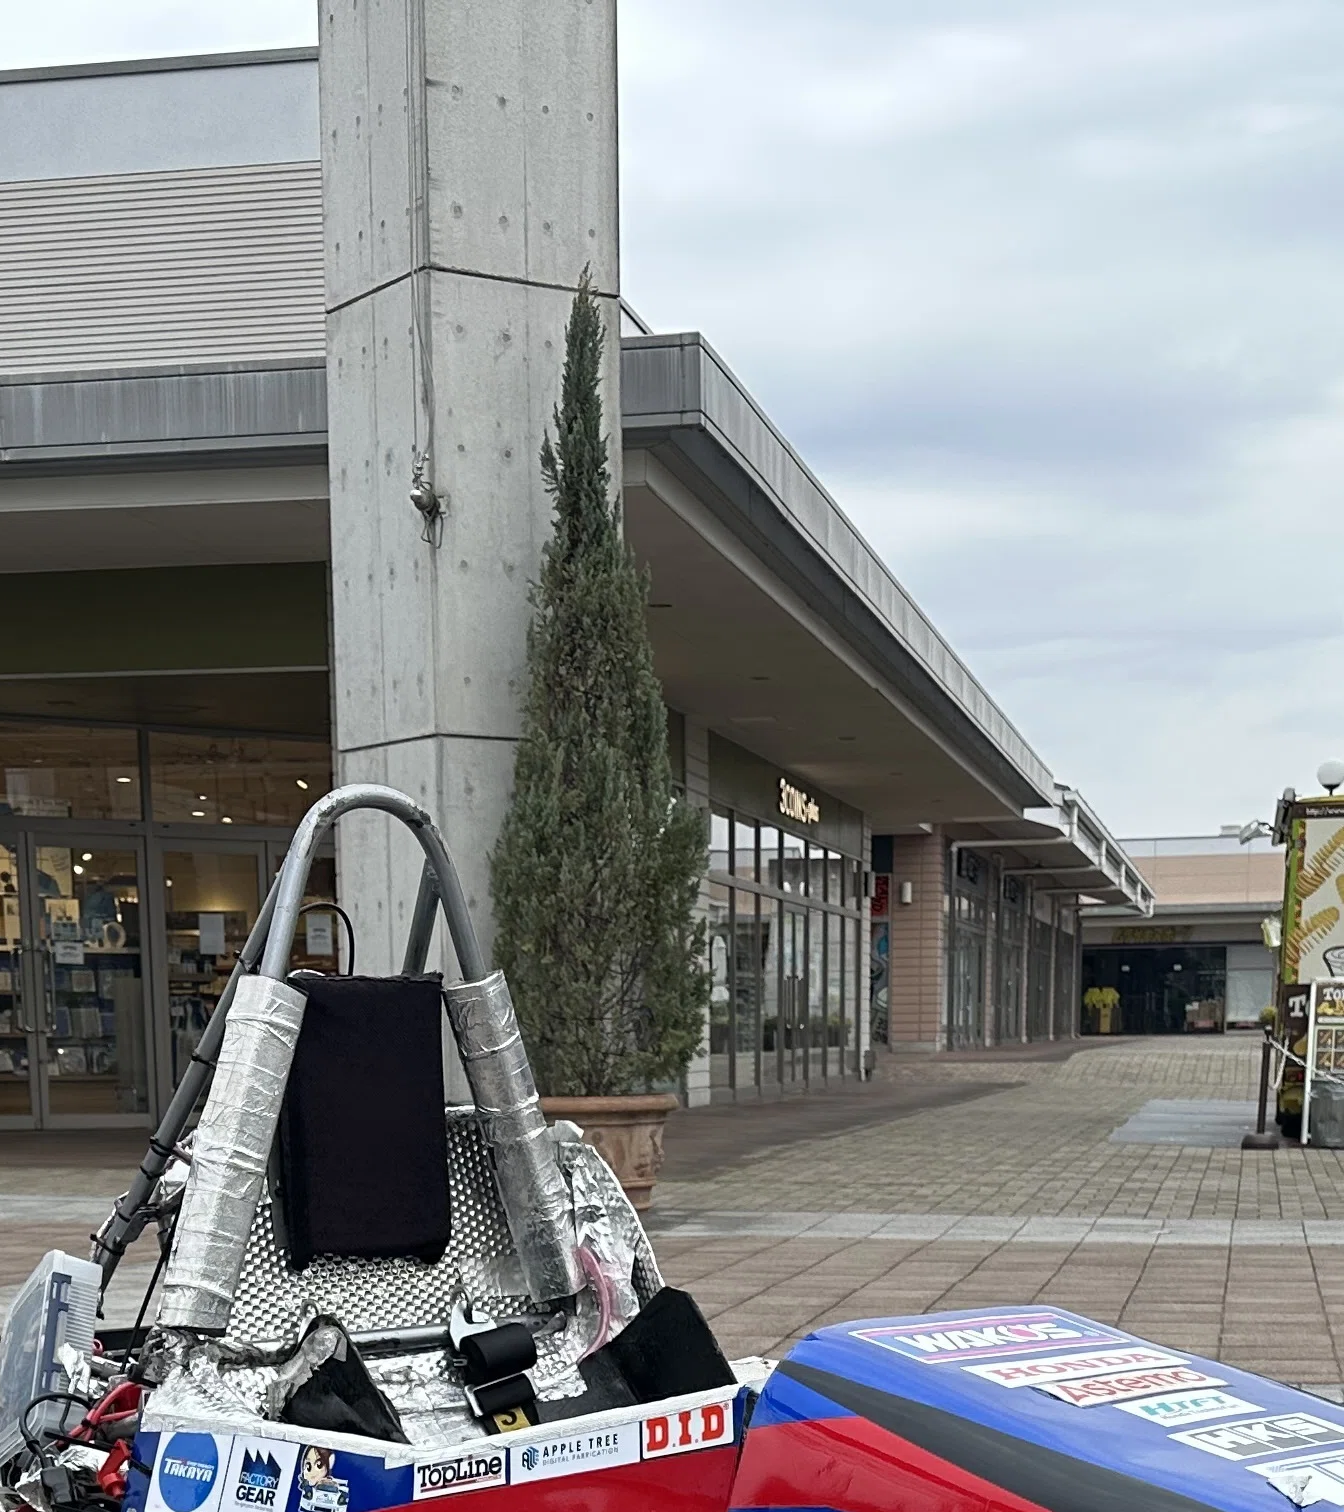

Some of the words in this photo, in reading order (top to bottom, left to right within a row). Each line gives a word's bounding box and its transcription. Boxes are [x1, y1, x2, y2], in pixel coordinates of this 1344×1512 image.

[987, 1353, 1167, 1380] HONDA
[1056, 1366, 1207, 1402] Astemo
[543, 1441, 582, 1458] APPLE
[589, 1433, 619, 1449] TREE
[1189, 1416, 1341, 1455] HKS
[164, 1458, 213, 1482] TAKAYA
[240, 1472, 280, 1488] FACTORY
[236, 1485, 276, 1506] GEAR
